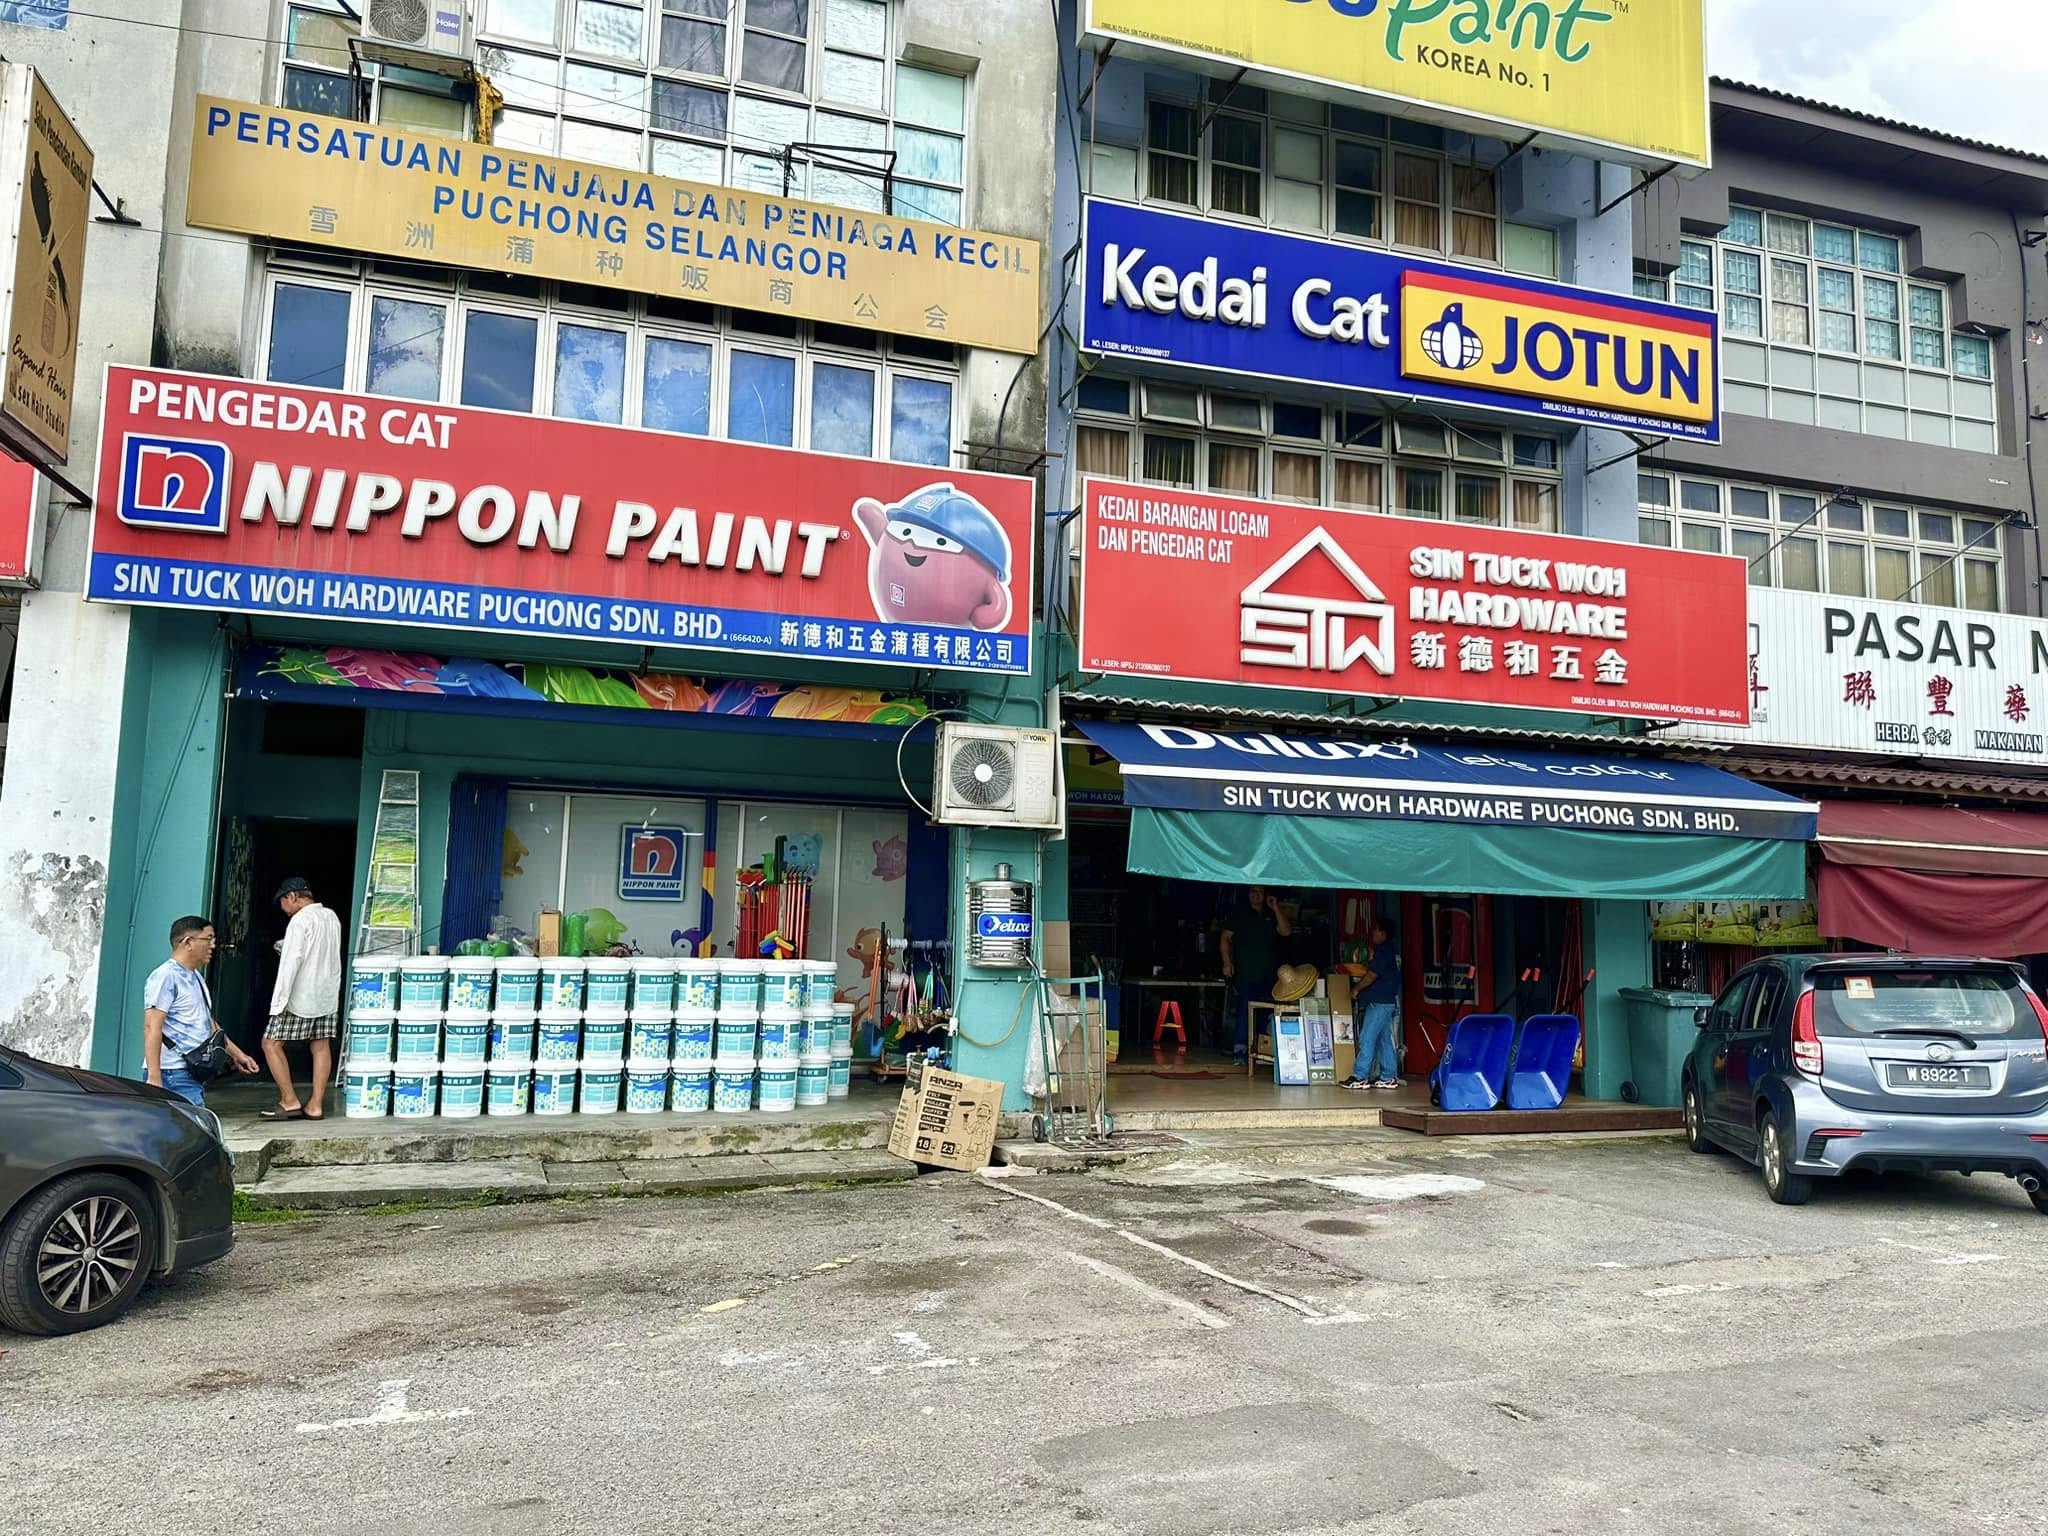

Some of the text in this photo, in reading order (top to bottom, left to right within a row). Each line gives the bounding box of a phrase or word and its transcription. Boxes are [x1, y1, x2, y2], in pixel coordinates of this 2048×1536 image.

[436, 18, 459, 29] Haier
[1417, 44, 1550, 92] KOREA No. 1
[207, 106, 1030, 274] PERSATUAN PENJAJA DAN PENIAGA KECIL
[433, 185, 848, 281] PUCHONG SELANGOR
[1103, 242, 1390, 348] Kedai Cat
[12, 334, 45, 374] Expand
[1492, 316, 1700, 405] JOTUN
[129, 378, 458, 449] PENGEDAR CAT
[240, 461, 841, 579] NIPPON PAINT
[1098, 494, 1269, 538] KEDAI BARANGAN LOGAM
[1098, 526, 1233, 563] DAN PENGEDAR CAT
[1409, 546, 1627, 598] SIN TUCK WOH
[113, 562, 772, 645] SIN TUCK WOH HARDWARE PUCHONG SDN. BHD. (666420-A)
[1409, 586, 1628, 640] HARDWARE
[780, 620, 1013, 664] 新德和五金蒲種有限公司
[1410, 630, 1628, 685] 新德和五金
[1823, 607, 1997, 670] PASAR
[1138, 723, 1409, 760] Dulux
[1875, 722, 1919, 744] HERBA
[1975, 730, 2043, 753] MAKANAN
[1223, 786, 1739, 832] SIN TUCK WOH HARDWARE PUCHONG SDN. BHD.
[622, 881, 680, 889] NIPPON PAINT
[1906, 1067, 1970, 1083] W 8922 T
[918, 1138, 929, 1149] 18
[942, 1143, 954, 1154] 23
